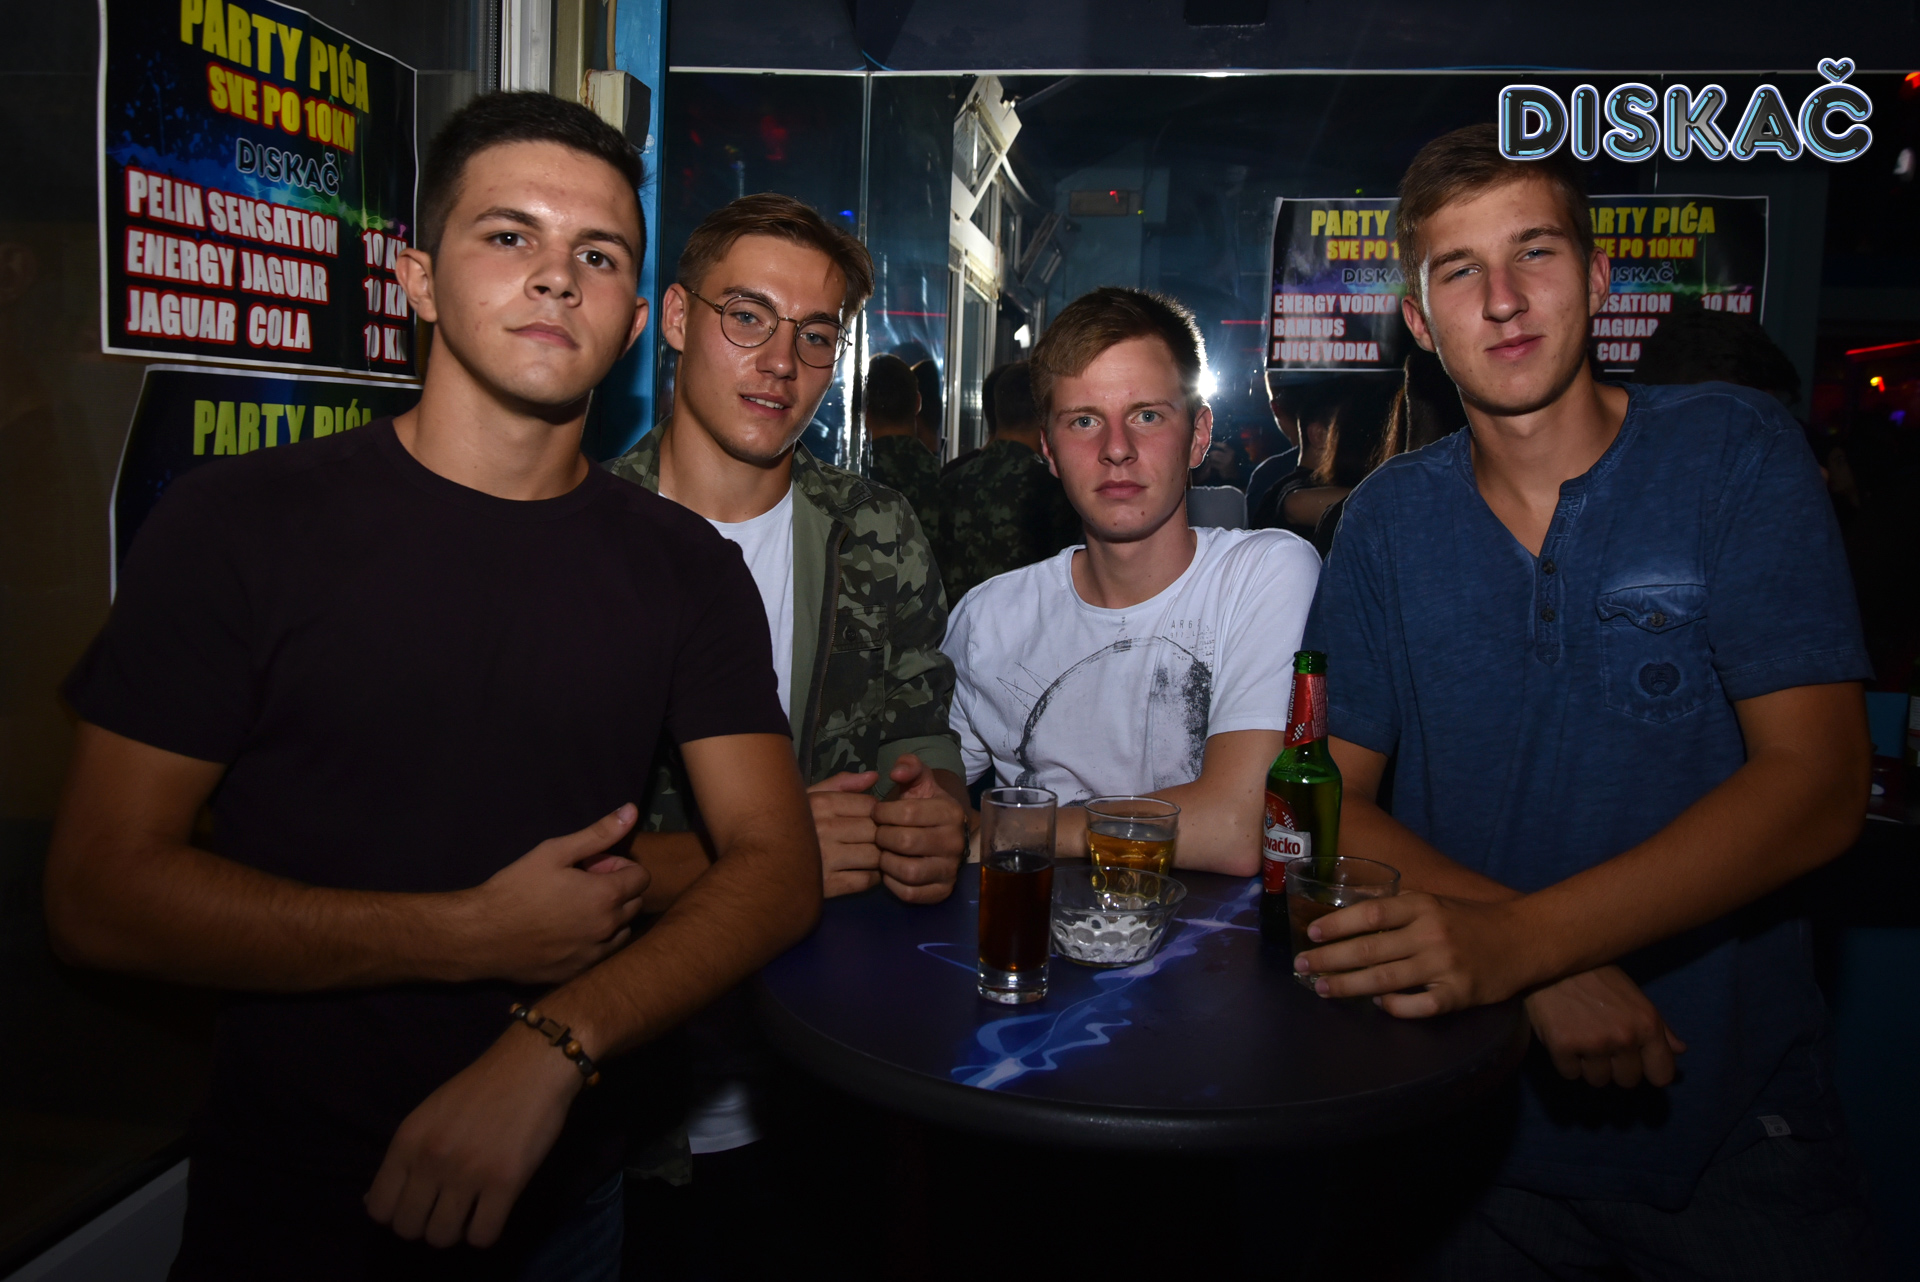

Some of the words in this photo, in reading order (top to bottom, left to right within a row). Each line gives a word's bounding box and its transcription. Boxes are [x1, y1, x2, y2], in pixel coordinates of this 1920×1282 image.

[181, 0, 303, 81] PARTY
[309, 35, 370, 114] PIĆA
[208, 65, 258, 124] SVE
[262, 85, 301, 133] PO
[304, 99, 355, 152] 10KN
[236, 137, 340, 196] DISKAČ
[127, 170, 205, 227] PELIN
[208, 191, 338, 256] SENSATION
[363, 231, 384, 267] 10
[1311, 210, 1390, 236] PARTY
[1652, 202, 1716, 234] PIĆA
[1327, 240, 1360, 260] SVE
[1363, 240, 1388, 260] PO
[1619, 238, 1644, 258] PO
[1647, 238, 1695, 258] 10KN
[127, 230, 235, 287] ENERGY
[241, 251, 328, 302] JAGUAR
[364, 278, 381, 313] 10
[1342, 268, 1404, 284] DISKA
[1610, 261, 1674, 283] ISKAČ
[1273, 294, 1337, 313] ENERGY
[1339, 294, 1397, 313] VODKA
[1701, 294, 1723, 311] 10
[1726, 294, 1752, 313] KN
[127, 290, 236, 342] JAGUAR
[249, 306, 311, 350] COLA
[364, 325, 380, 359] 10
[384, 326, 407, 362] KN
[1273, 318, 1345, 337] BAMBUS
[1272, 342, 1319, 361] JUICE
[1322, 342, 1379, 361] VODKA
[1596, 343, 1641, 361] COLA
[193, 399, 306, 456] PARTY
[1264, 835, 1301, 855] ovačko
